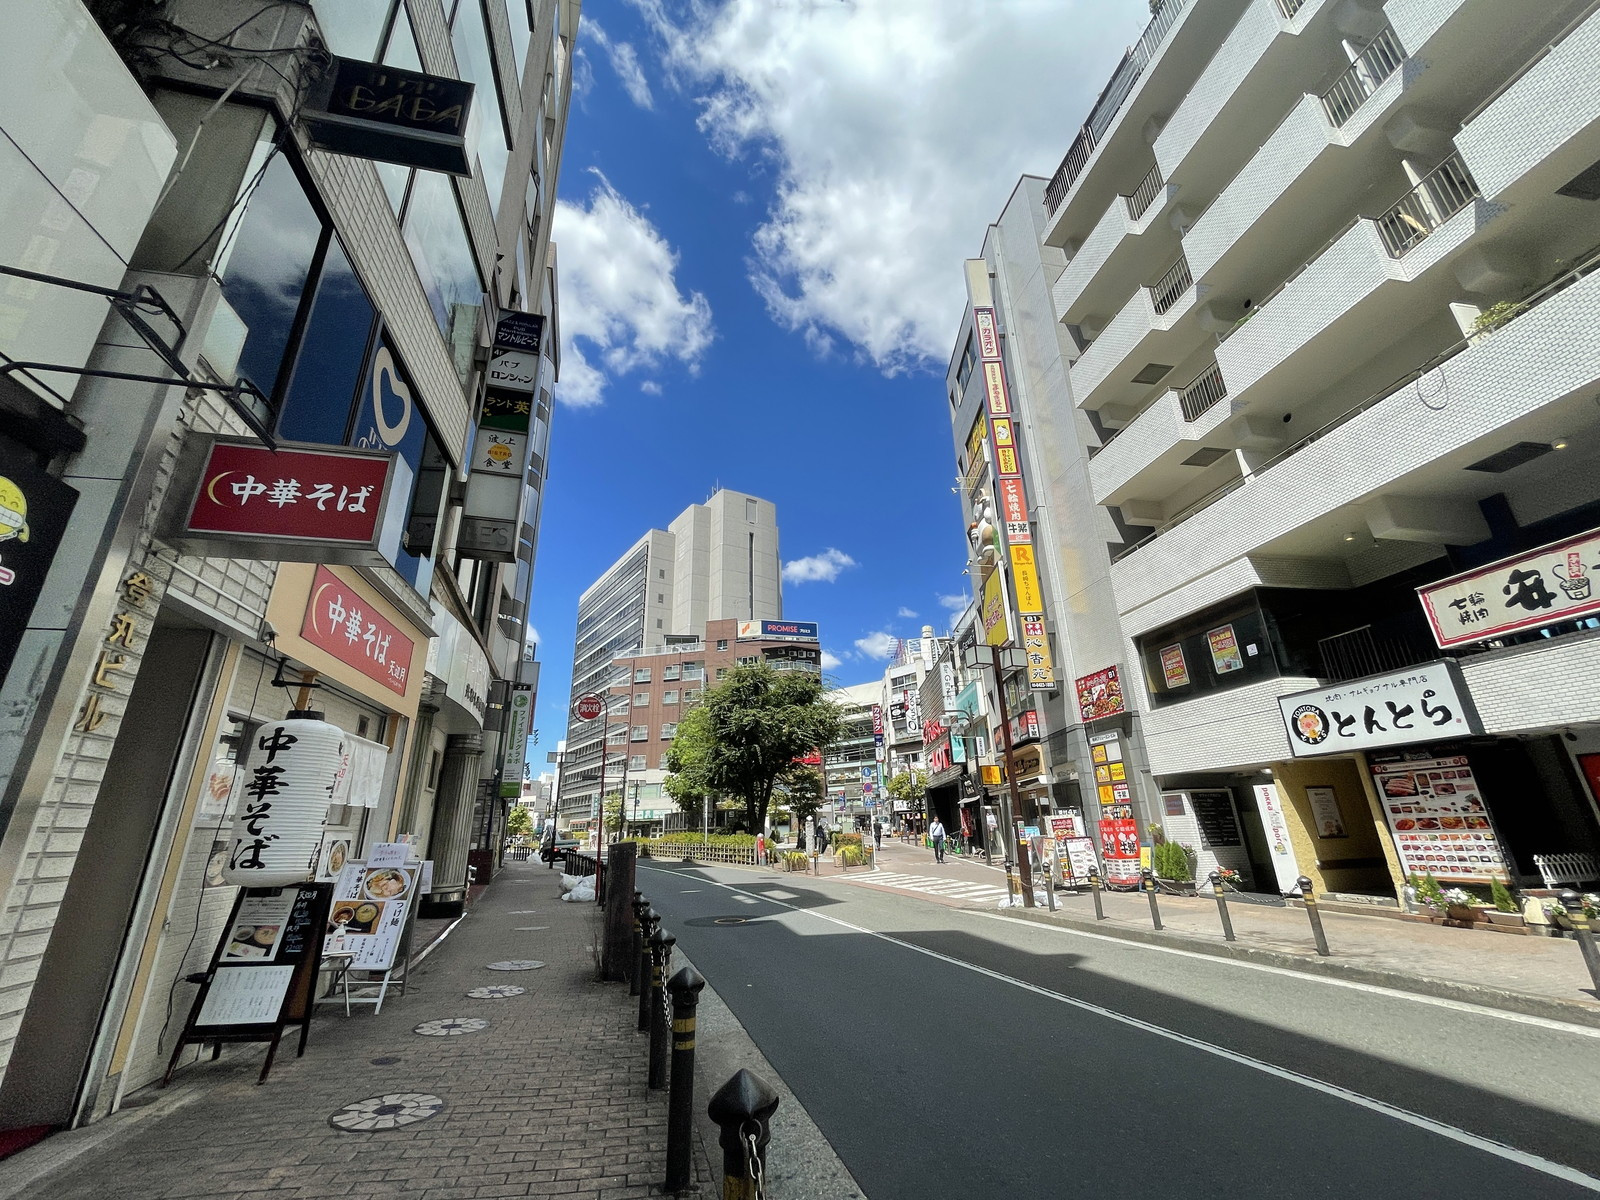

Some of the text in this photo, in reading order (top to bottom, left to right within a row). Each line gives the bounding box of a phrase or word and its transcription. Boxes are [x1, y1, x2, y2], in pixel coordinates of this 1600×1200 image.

[491, 370, 533, 383] ロンシャン
[487, 449, 512, 458] BISTRO
[483, 457, 512, 469] 食堂
[230, 474, 374, 513] 中華そば
[1006, 484, 1021, 520] 七輪焼肉
[1008, 522, 1028, 533] 牛繁
[1448, 591, 1486, 610] 七輪
[1458, 607, 1489, 625] 焼肉
[328, 594, 392, 666] 中華そば
[767, 624, 798, 633] PROMISE
[579, 703, 600, 713] 消火栓
[1293, 704, 1320, 719] TONTORA
[1330, 688, 1453, 738] とんとら
[873, 707, 881, 731] カラオケ
[229, 727, 298, 870] 中華そば
